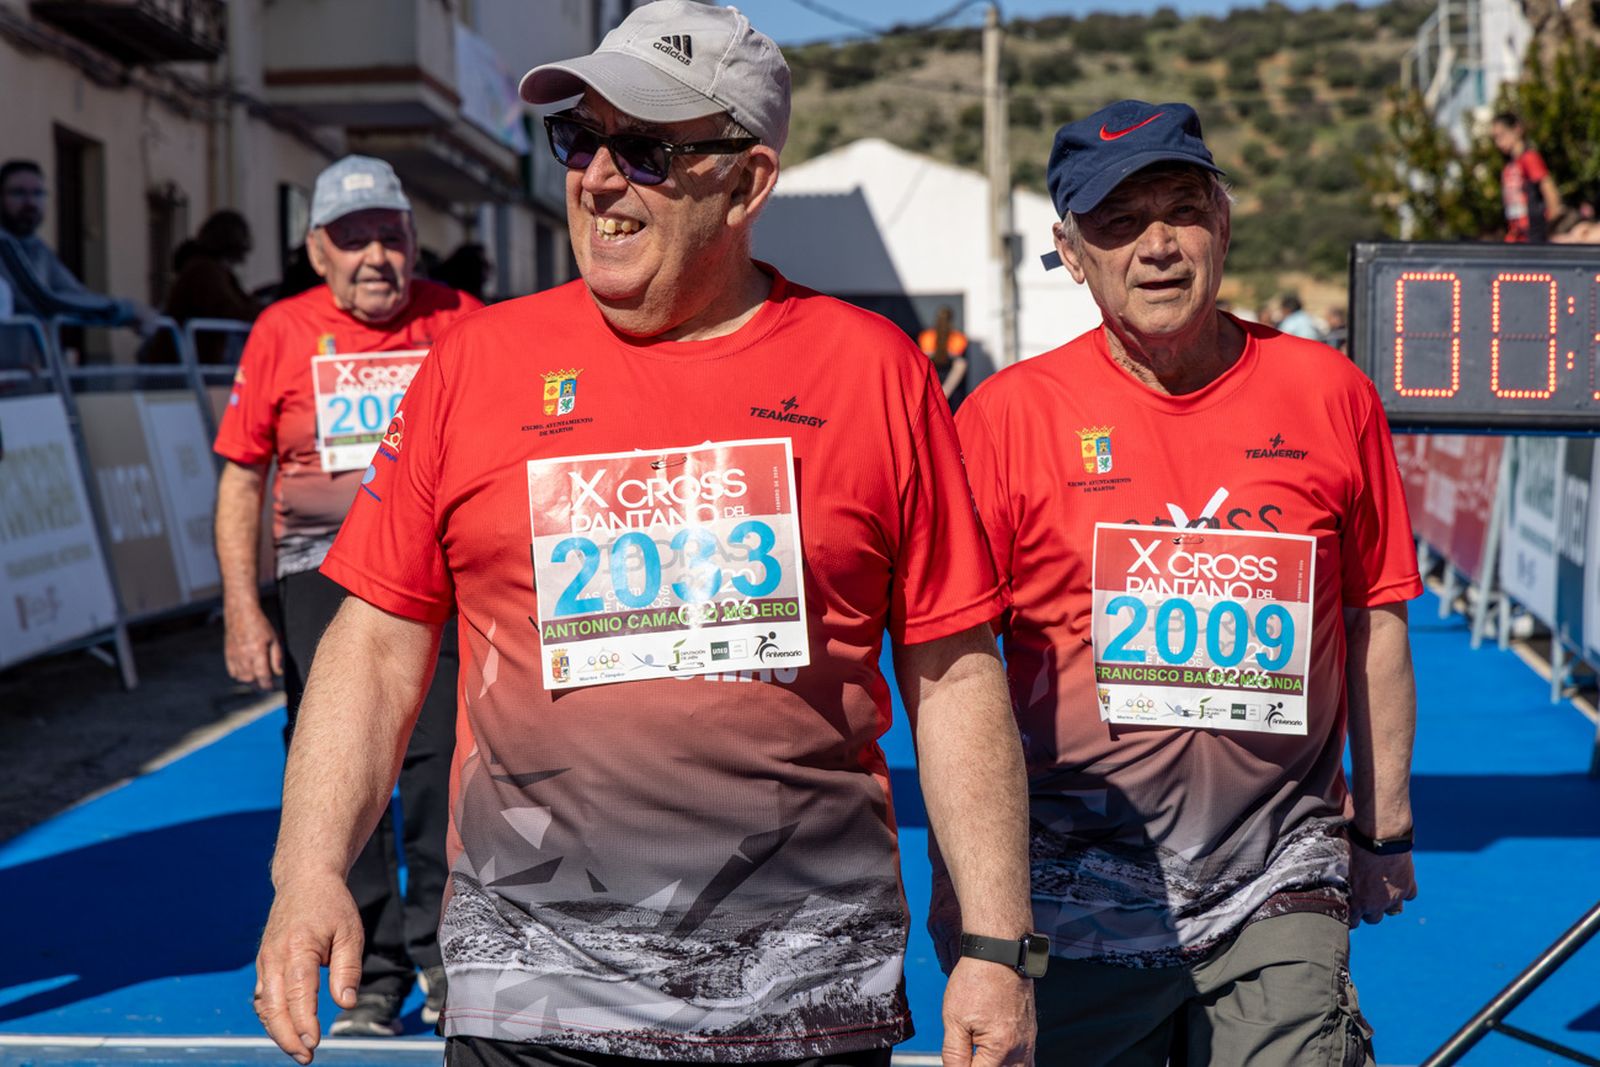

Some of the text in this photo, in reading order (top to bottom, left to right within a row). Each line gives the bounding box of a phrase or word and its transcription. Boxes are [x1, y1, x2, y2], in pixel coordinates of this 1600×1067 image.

[653, 42, 691, 66] adidas
[1395, 272, 1600, 398] 00:
[334, 361, 355, 383] X
[750, 407, 828, 428] TEAMERGY
[1245, 448, 1308, 460] TEAMERGY
[568, 468, 748, 511] X CROSS
[571, 503, 750, 537] PANTANO DEL
[550, 520, 782, 617] 2033
[1126, 537, 1162, 575] X
[1167, 551, 1278, 583] CROSS
[1126, 576, 1276, 602] PANTANO DEL
[543, 601, 798, 640] ANTONIO CAMACO MELERO
[1102, 595, 1295, 671] 2009
[765, 650, 803, 658] Aniversario
[1097, 666, 1180, 683] FRANCISCO
[1240, 673, 1303, 691] MIRANDA
